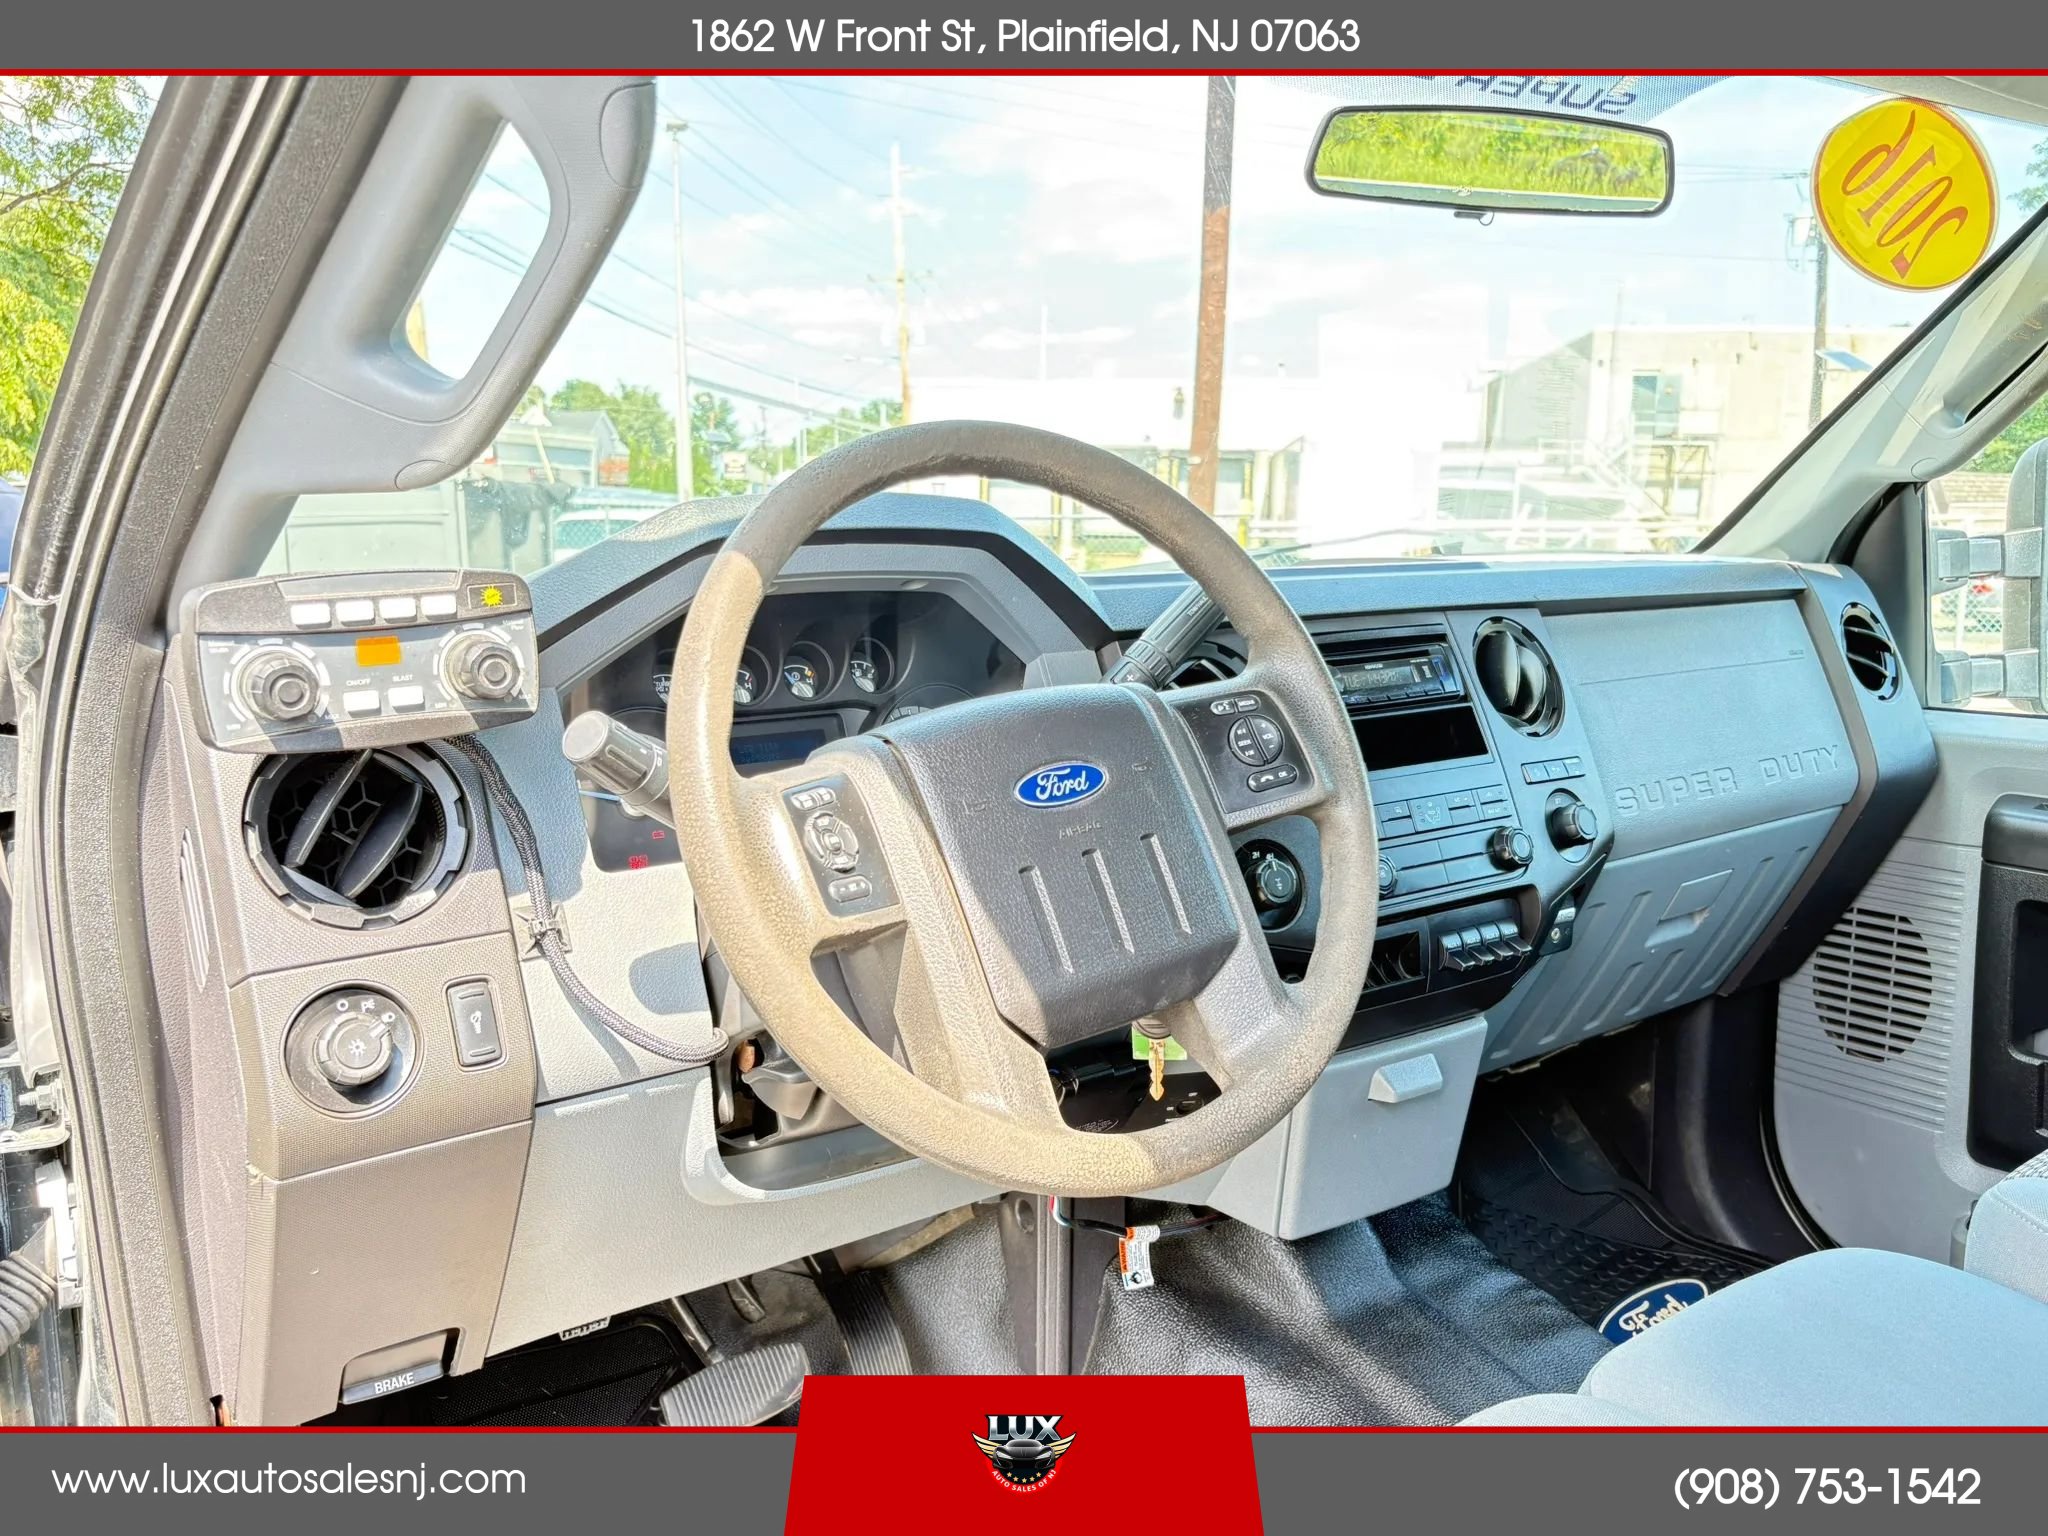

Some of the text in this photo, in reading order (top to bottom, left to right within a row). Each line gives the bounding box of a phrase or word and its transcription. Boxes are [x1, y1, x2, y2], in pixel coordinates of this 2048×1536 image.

[1035, 767, 1089, 801] Ford
[1614, 745, 1838, 817] SUPER DUTY
[1618, 1293, 1689, 1338] Ford
[374, 1372, 415, 1395] BRAKE
